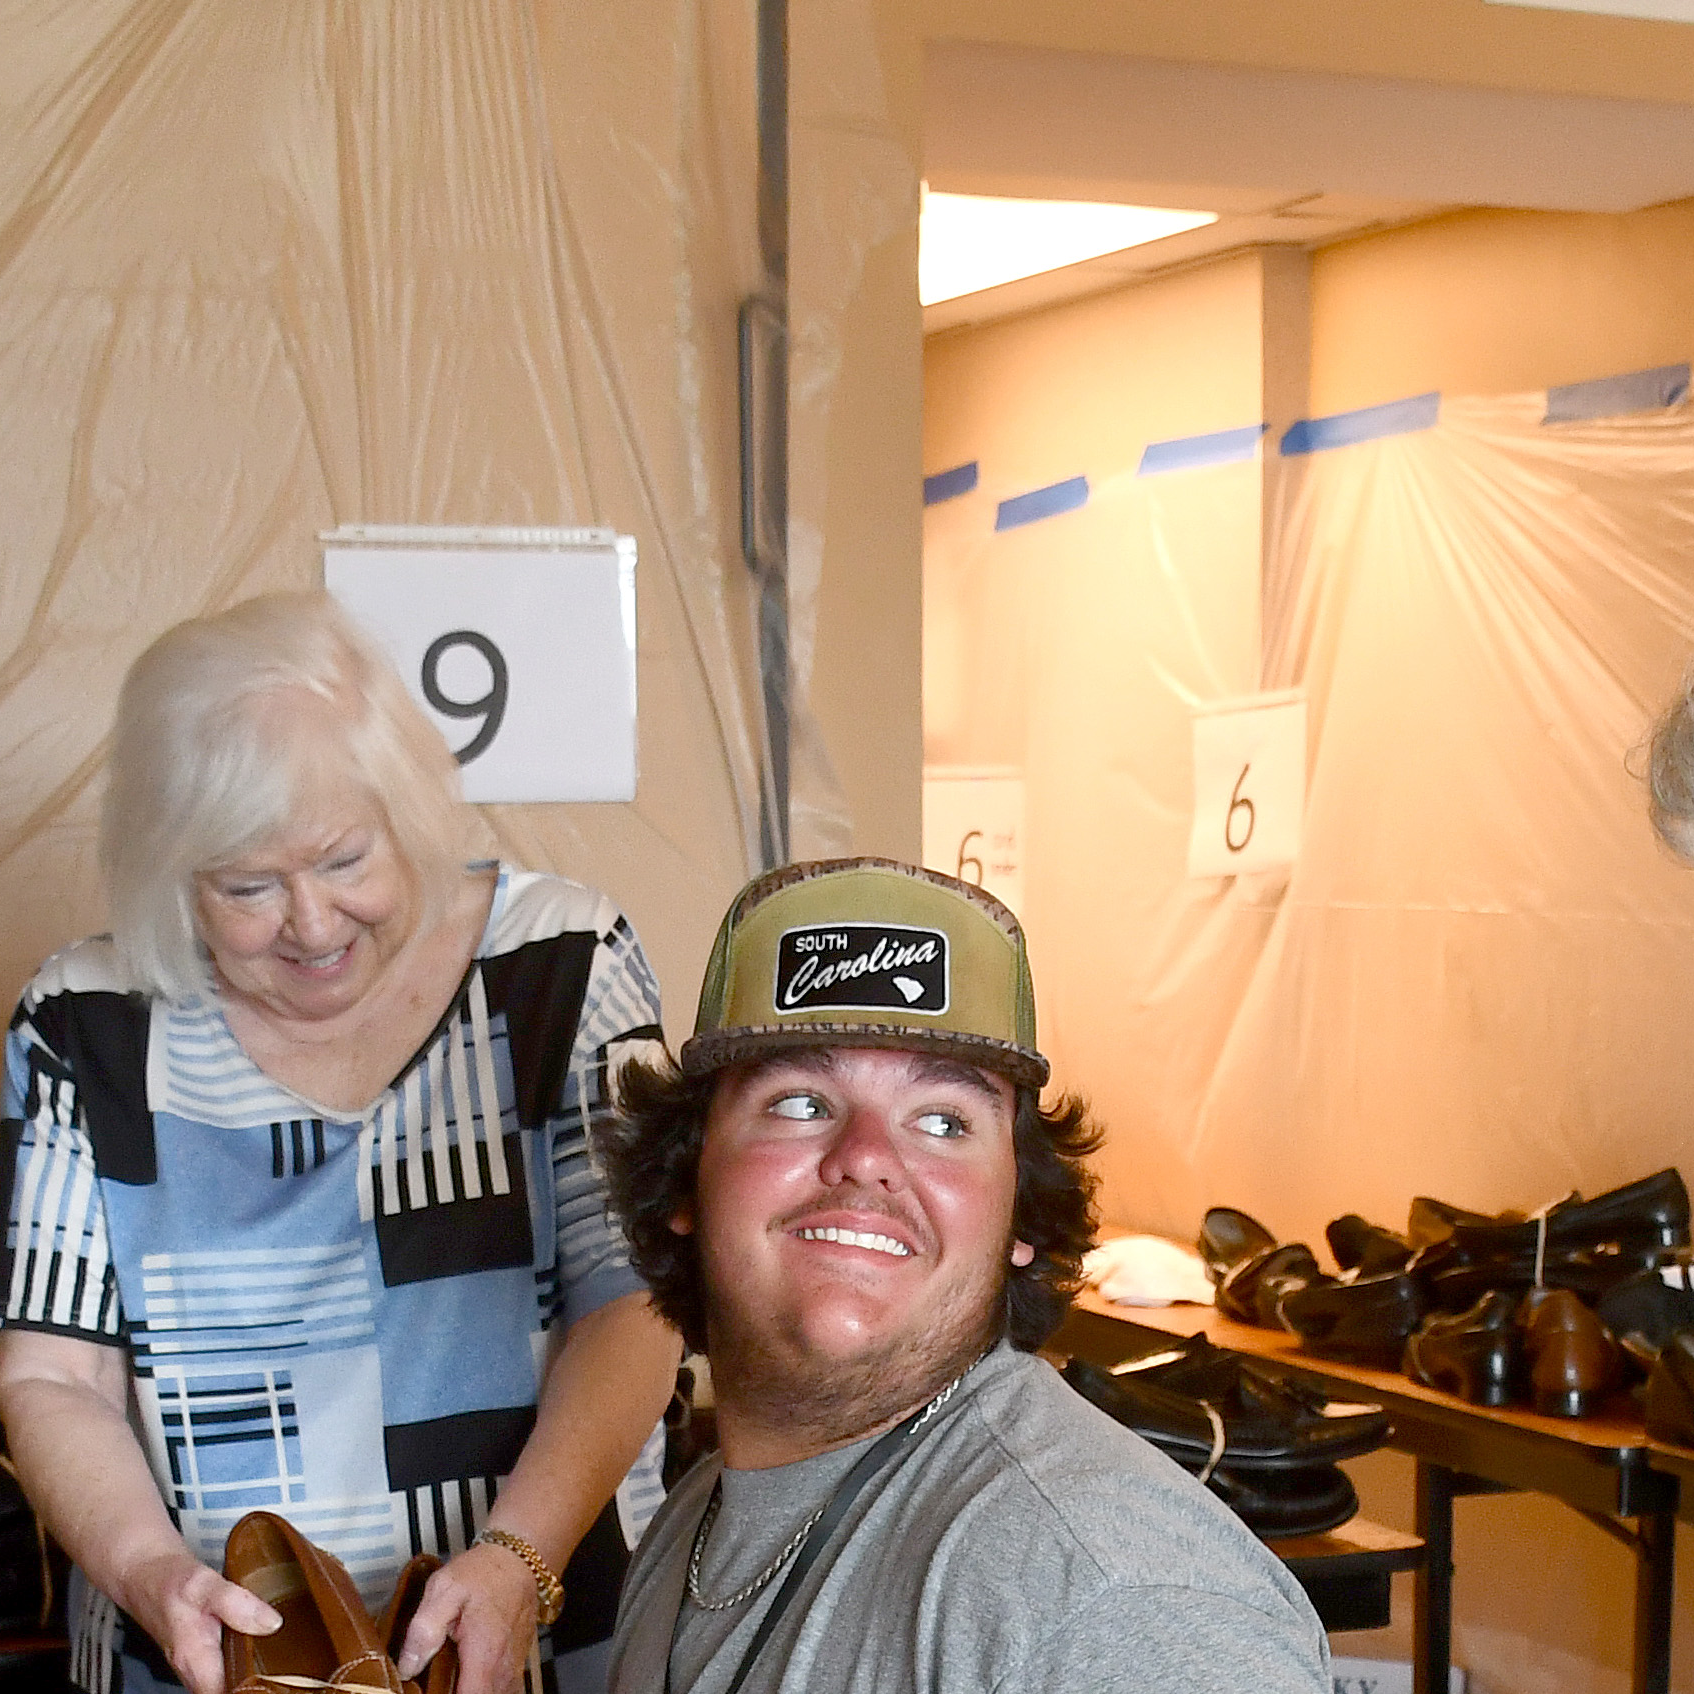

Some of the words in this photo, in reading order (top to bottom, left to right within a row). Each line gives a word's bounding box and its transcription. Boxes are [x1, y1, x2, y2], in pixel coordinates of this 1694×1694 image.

[421, 630, 509, 767] 9
[1224, 762, 1256, 853] 6
[957, 830, 984, 886] 6
[783, 936, 940, 1006] Carolina
[795, 933, 848, 953] SOUTH
